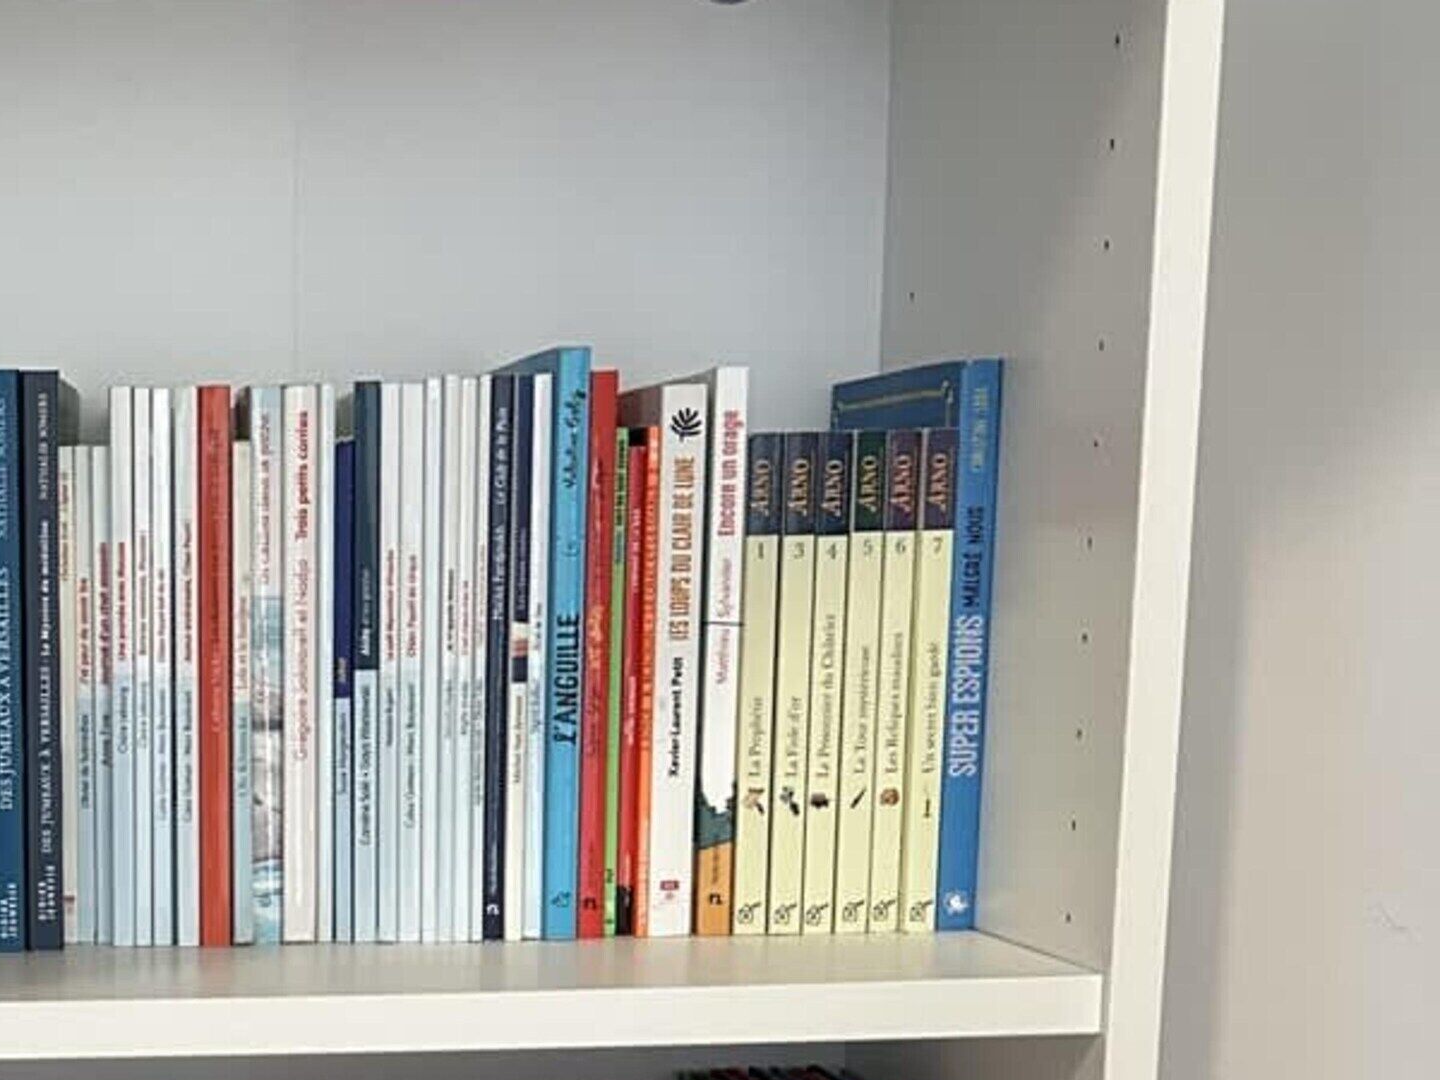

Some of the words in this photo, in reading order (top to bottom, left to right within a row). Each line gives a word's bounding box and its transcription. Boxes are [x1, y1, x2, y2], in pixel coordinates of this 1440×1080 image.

[295, 410, 308, 460] contes
[721, 410, 743, 455] orage
[294, 463, 310, 505] petits
[673, 456, 695, 489] LUNE
[720, 461, 737, 480] un
[788, 458, 809, 516] ARNO
[856, 455, 877, 513] ARNO
[890, 454, 912, 512] ARNO
[927, 453, 948, 511] ARNO
[673, 491, 693, 509] DE
[750, 459, 771, 517] ARNO
[821, 459, 844, 517] ARNO
[294, 507, 308, 540] Trois
[717, 482, 737, 537] Encore
[671, 512, 692, 550] CLAIR
[863, 538, 873, 557] 5
[895, 537, 907, 554] 6
[933, 537, 943, 553] 7
[670, 554, 691, 573] DU
[793, 541, 805, 559] 3
[828, 542, 837, 560] 4
[669, 577, 691, 617] LOUPS
[668, 621, 689, 641] LES
[670, 656, 685, 687] Petit
[949, 615, 984, 701] ESPIONS
[39, 666, 51, 743] VERSAILLES
[786, 696, 800, 722] d'or
[668, 689, 682, 777] Xavier-Laurent
[854, 723, 867, 751] Tour
[923, 713, 936, 749] secret
[949, 710, 980, 777] SUPER
[748, 758, 761, 777] La
[785, 758, 798, 777] La
[854, 754, 866, 773] La
[886, 752, 898, 773] Les
[920, 753, 934, 774] Un
[0, 779, 13, 809] DES
[40, 763, 54, 825] JUMEAUX
[42, 829, 51, 853] DES
